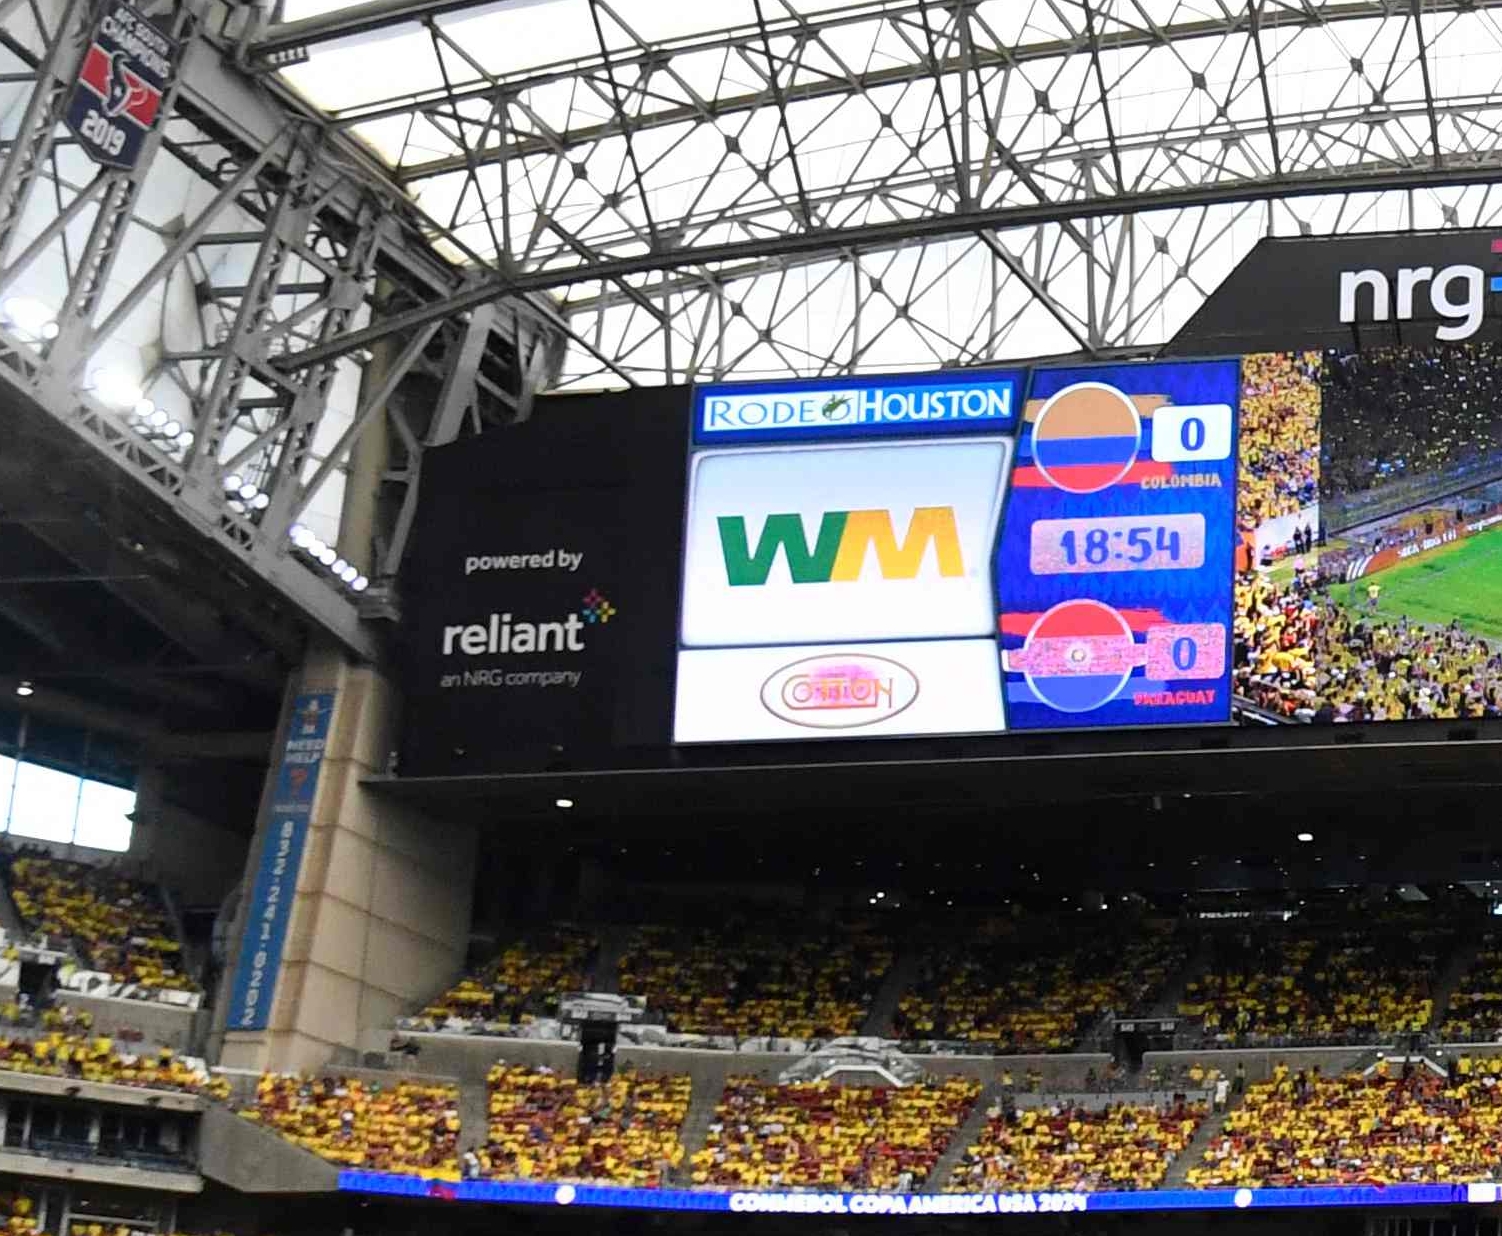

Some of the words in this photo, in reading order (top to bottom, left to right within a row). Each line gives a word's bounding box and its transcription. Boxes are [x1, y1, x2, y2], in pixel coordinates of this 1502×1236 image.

[80, 109, 126, 156] 2019
[1340, 264, 1484, 341] nrg
[1180, 417, 1206, 452] 0
[1139, 472, 1222, 490] COLOMBIA
[464, 548, 556, 576] powered
[557, 548, 584, 572] by
[717, 506, 966, 586] WM
[1059, 525, 1181, 566] 18:54
[442, 612, 586, 656] reliant
[1172, 636, 1198, 672] 0
[440, 673, 461, 688] an
[463, 669, 503, 687] NRG
[504, 669, 583, 688] company
[729, 1193, 848, 1213] CONMEBOL
[849, 1194, 908, 1214] COPA
[906, 1194, 998, 1214] AMERICA
[998, 1193, 1036, 1213] USA
[1037, 1193, 1089, 1212] 2024
